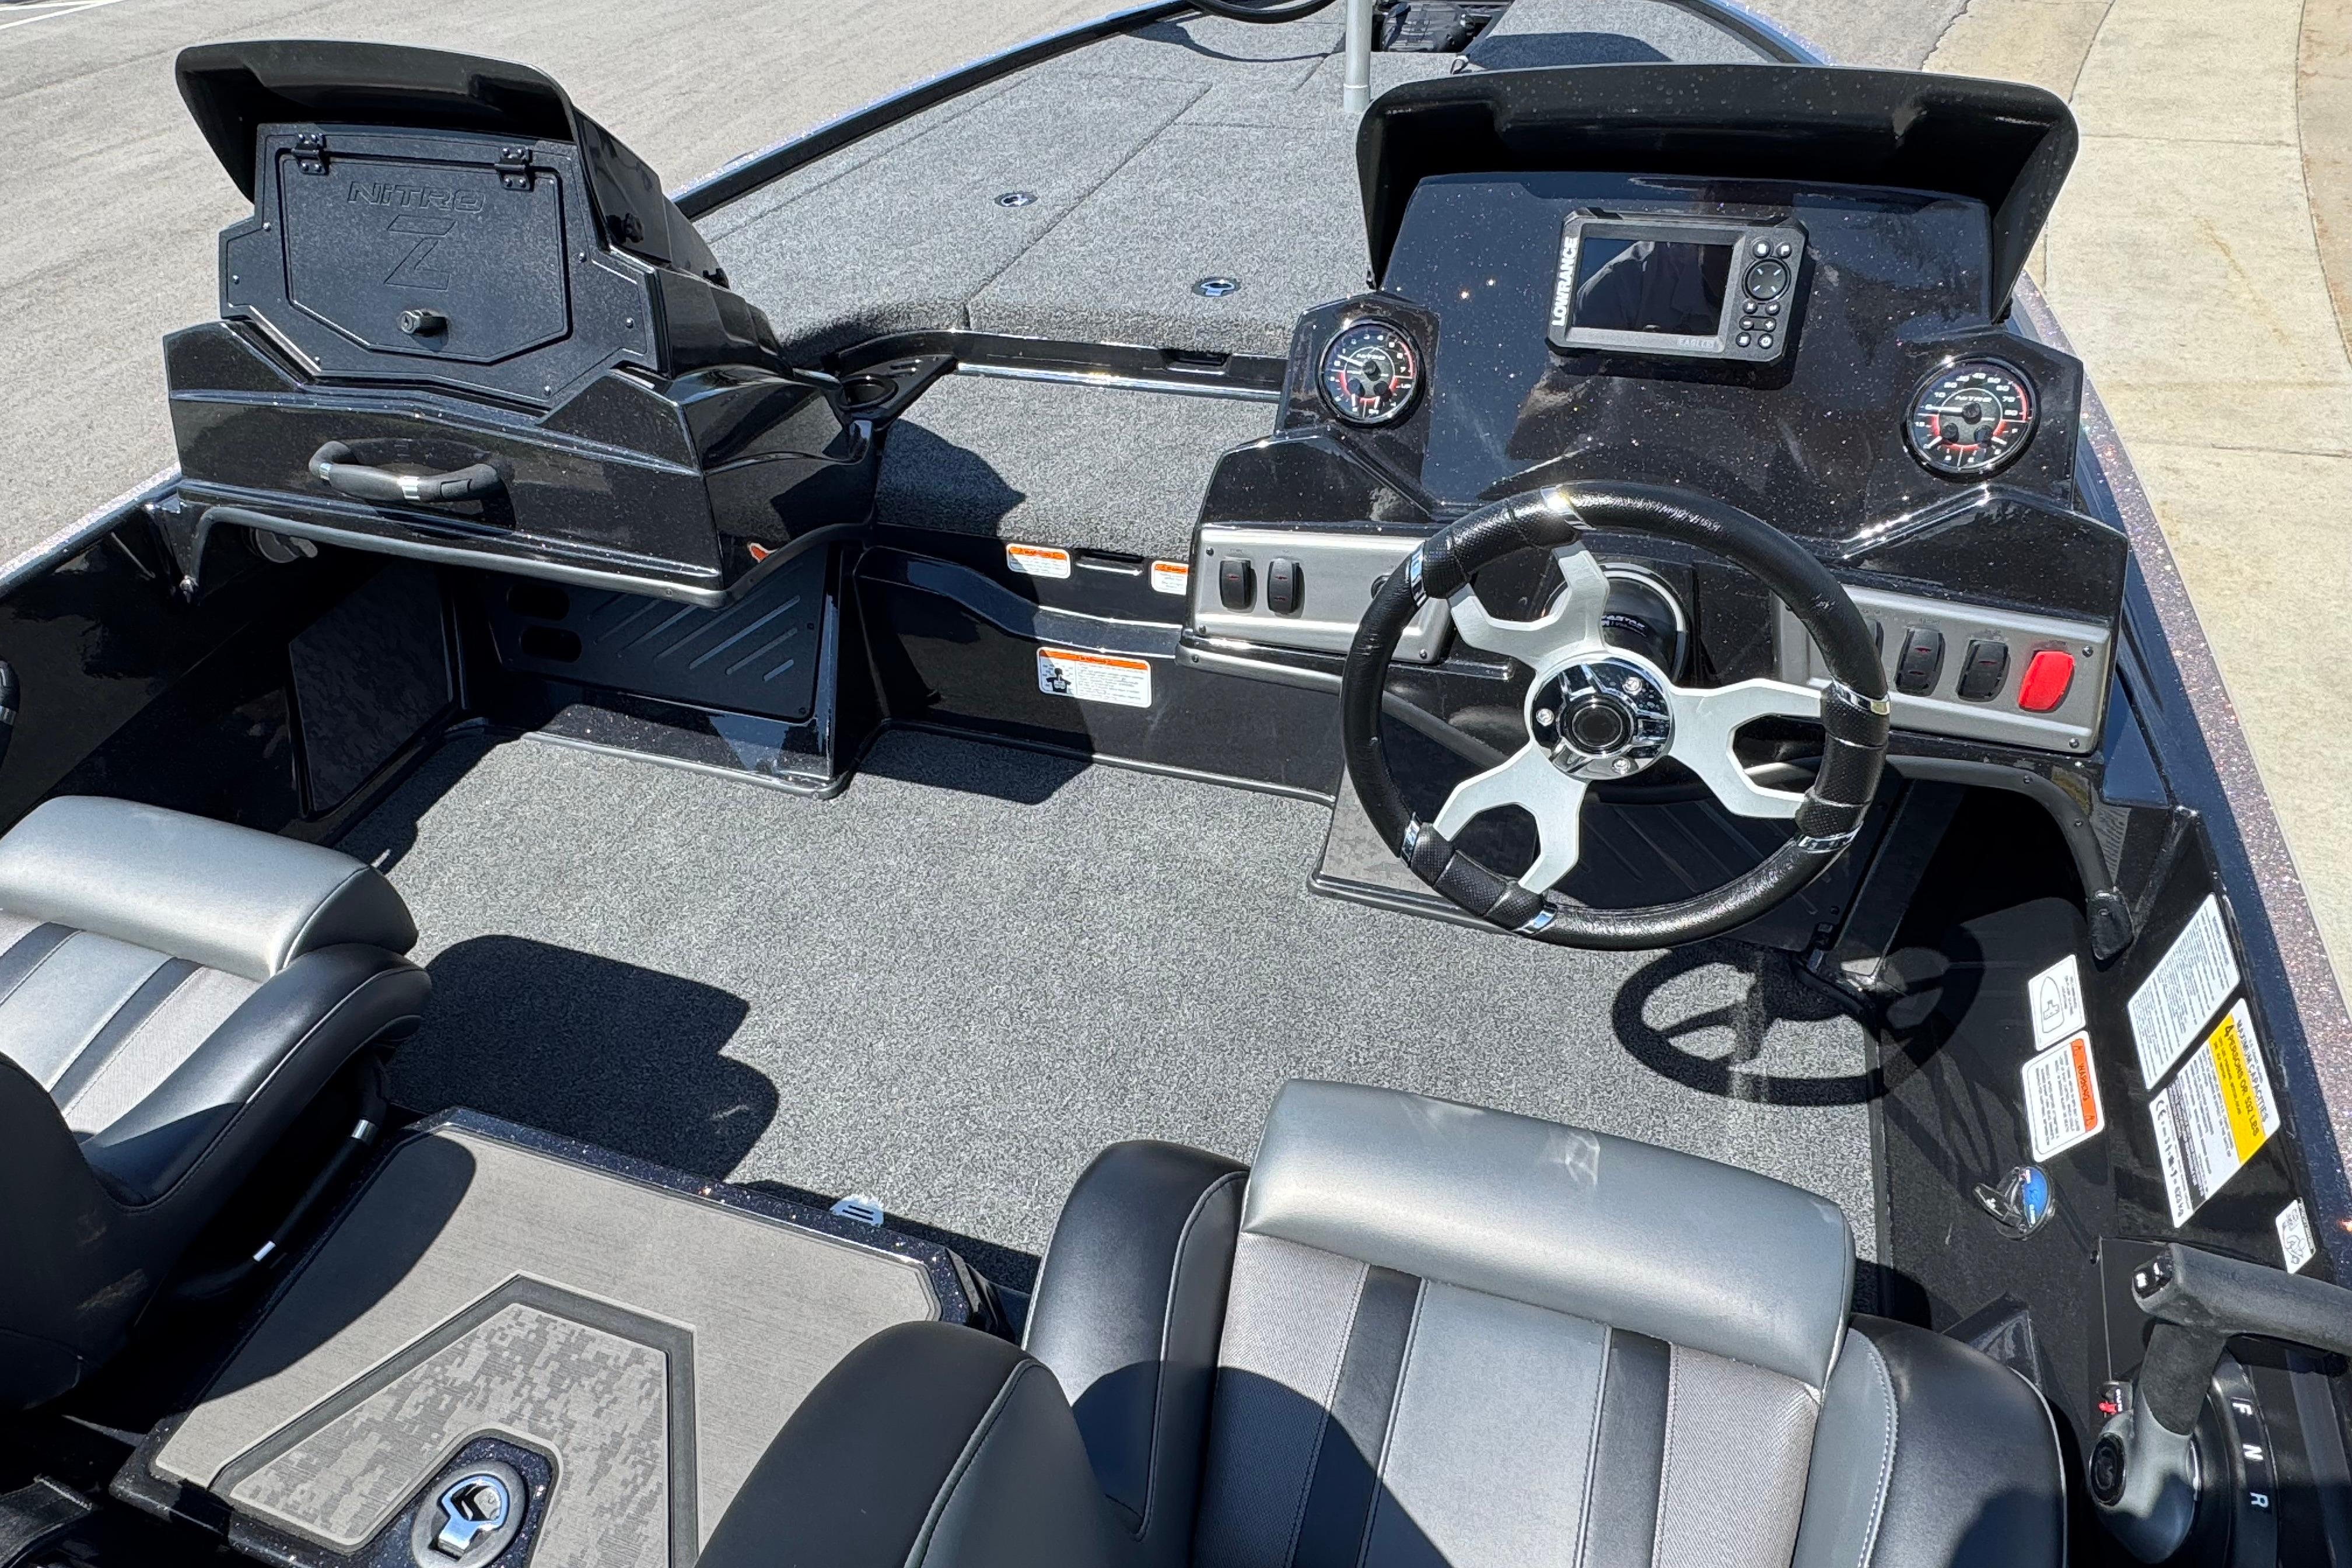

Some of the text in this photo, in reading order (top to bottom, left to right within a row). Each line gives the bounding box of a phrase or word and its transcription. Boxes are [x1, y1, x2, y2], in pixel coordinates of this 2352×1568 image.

[347, 181, 486, 214] NITRO
[383, 214, 458, 292] Z
[1551, 236, 1577, 327] LOWRANCE
[2224, 1024, 2235, 1037] 4
[2228, 1034, 2244, 1078] PERSONS
[2236, 1019, 2269, 1124] MAXIMUM CAPACITIES
[2240, 1077, 2248, 1093] OR
[2249, 1115, 2259, 1137] LBS
[2232, 1402, 2253, 1415] F
[2243, 1444, 2263, 1461] N
[2249, 1492, 2269, 1508] R
